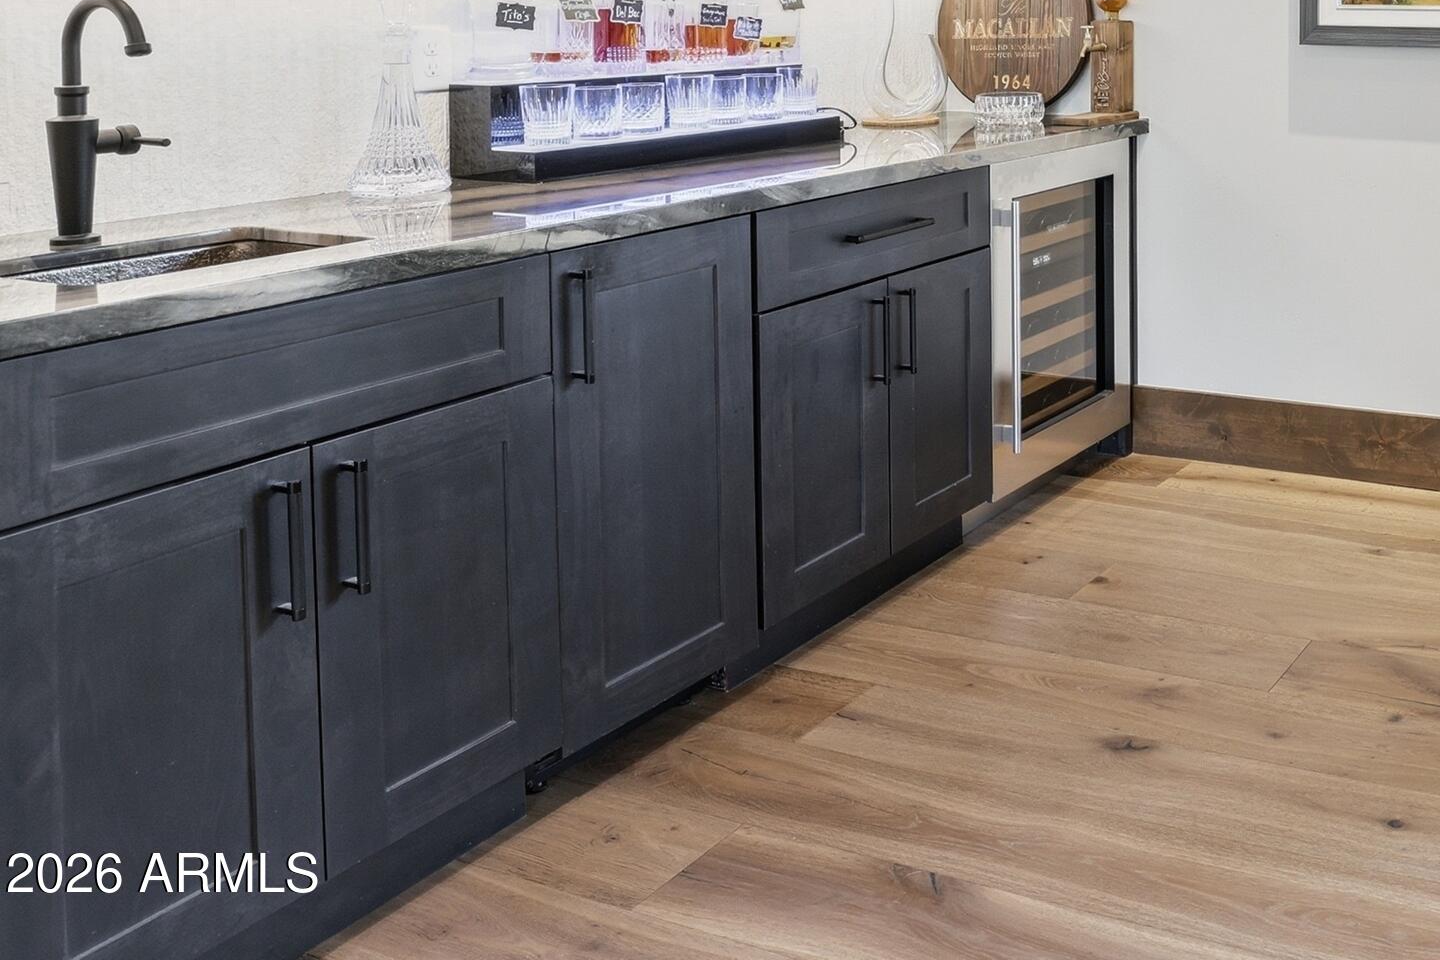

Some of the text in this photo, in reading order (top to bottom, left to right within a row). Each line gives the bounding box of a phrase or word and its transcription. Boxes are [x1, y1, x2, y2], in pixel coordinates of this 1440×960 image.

[501, 8, 530, 22] Tito's
[952, 16, 1074, 40] MACALLAN
[993, 74, 1031, 90] 1964
